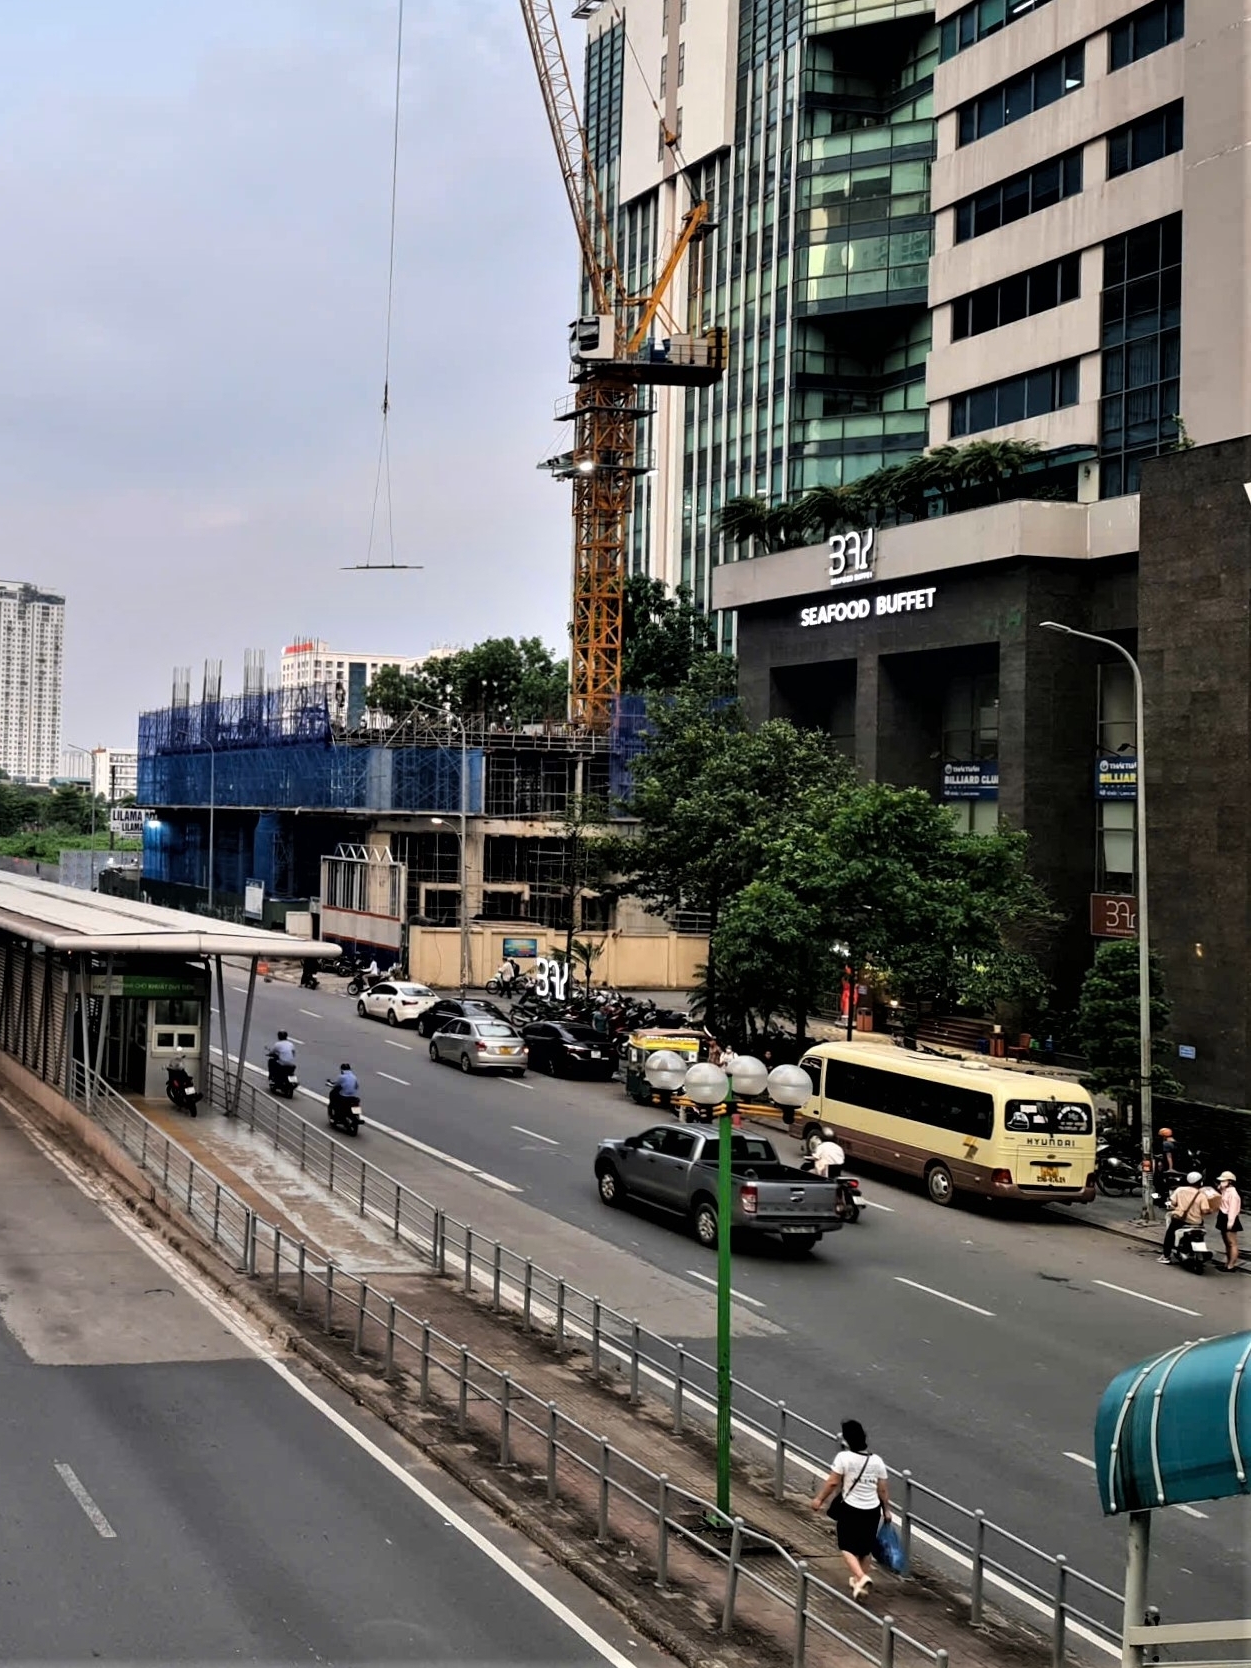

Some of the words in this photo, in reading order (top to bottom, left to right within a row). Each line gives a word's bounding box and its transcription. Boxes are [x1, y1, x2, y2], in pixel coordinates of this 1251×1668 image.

[801, 598, 870, 627] SEAFOOD
[876, 587, 937, 616] BUFFET
[944, 775, 980, 785] BILLIARD
[113, 810, 143, 821] LILAMA
[1027, 1138, 1076, 1147] HYUNDAI
